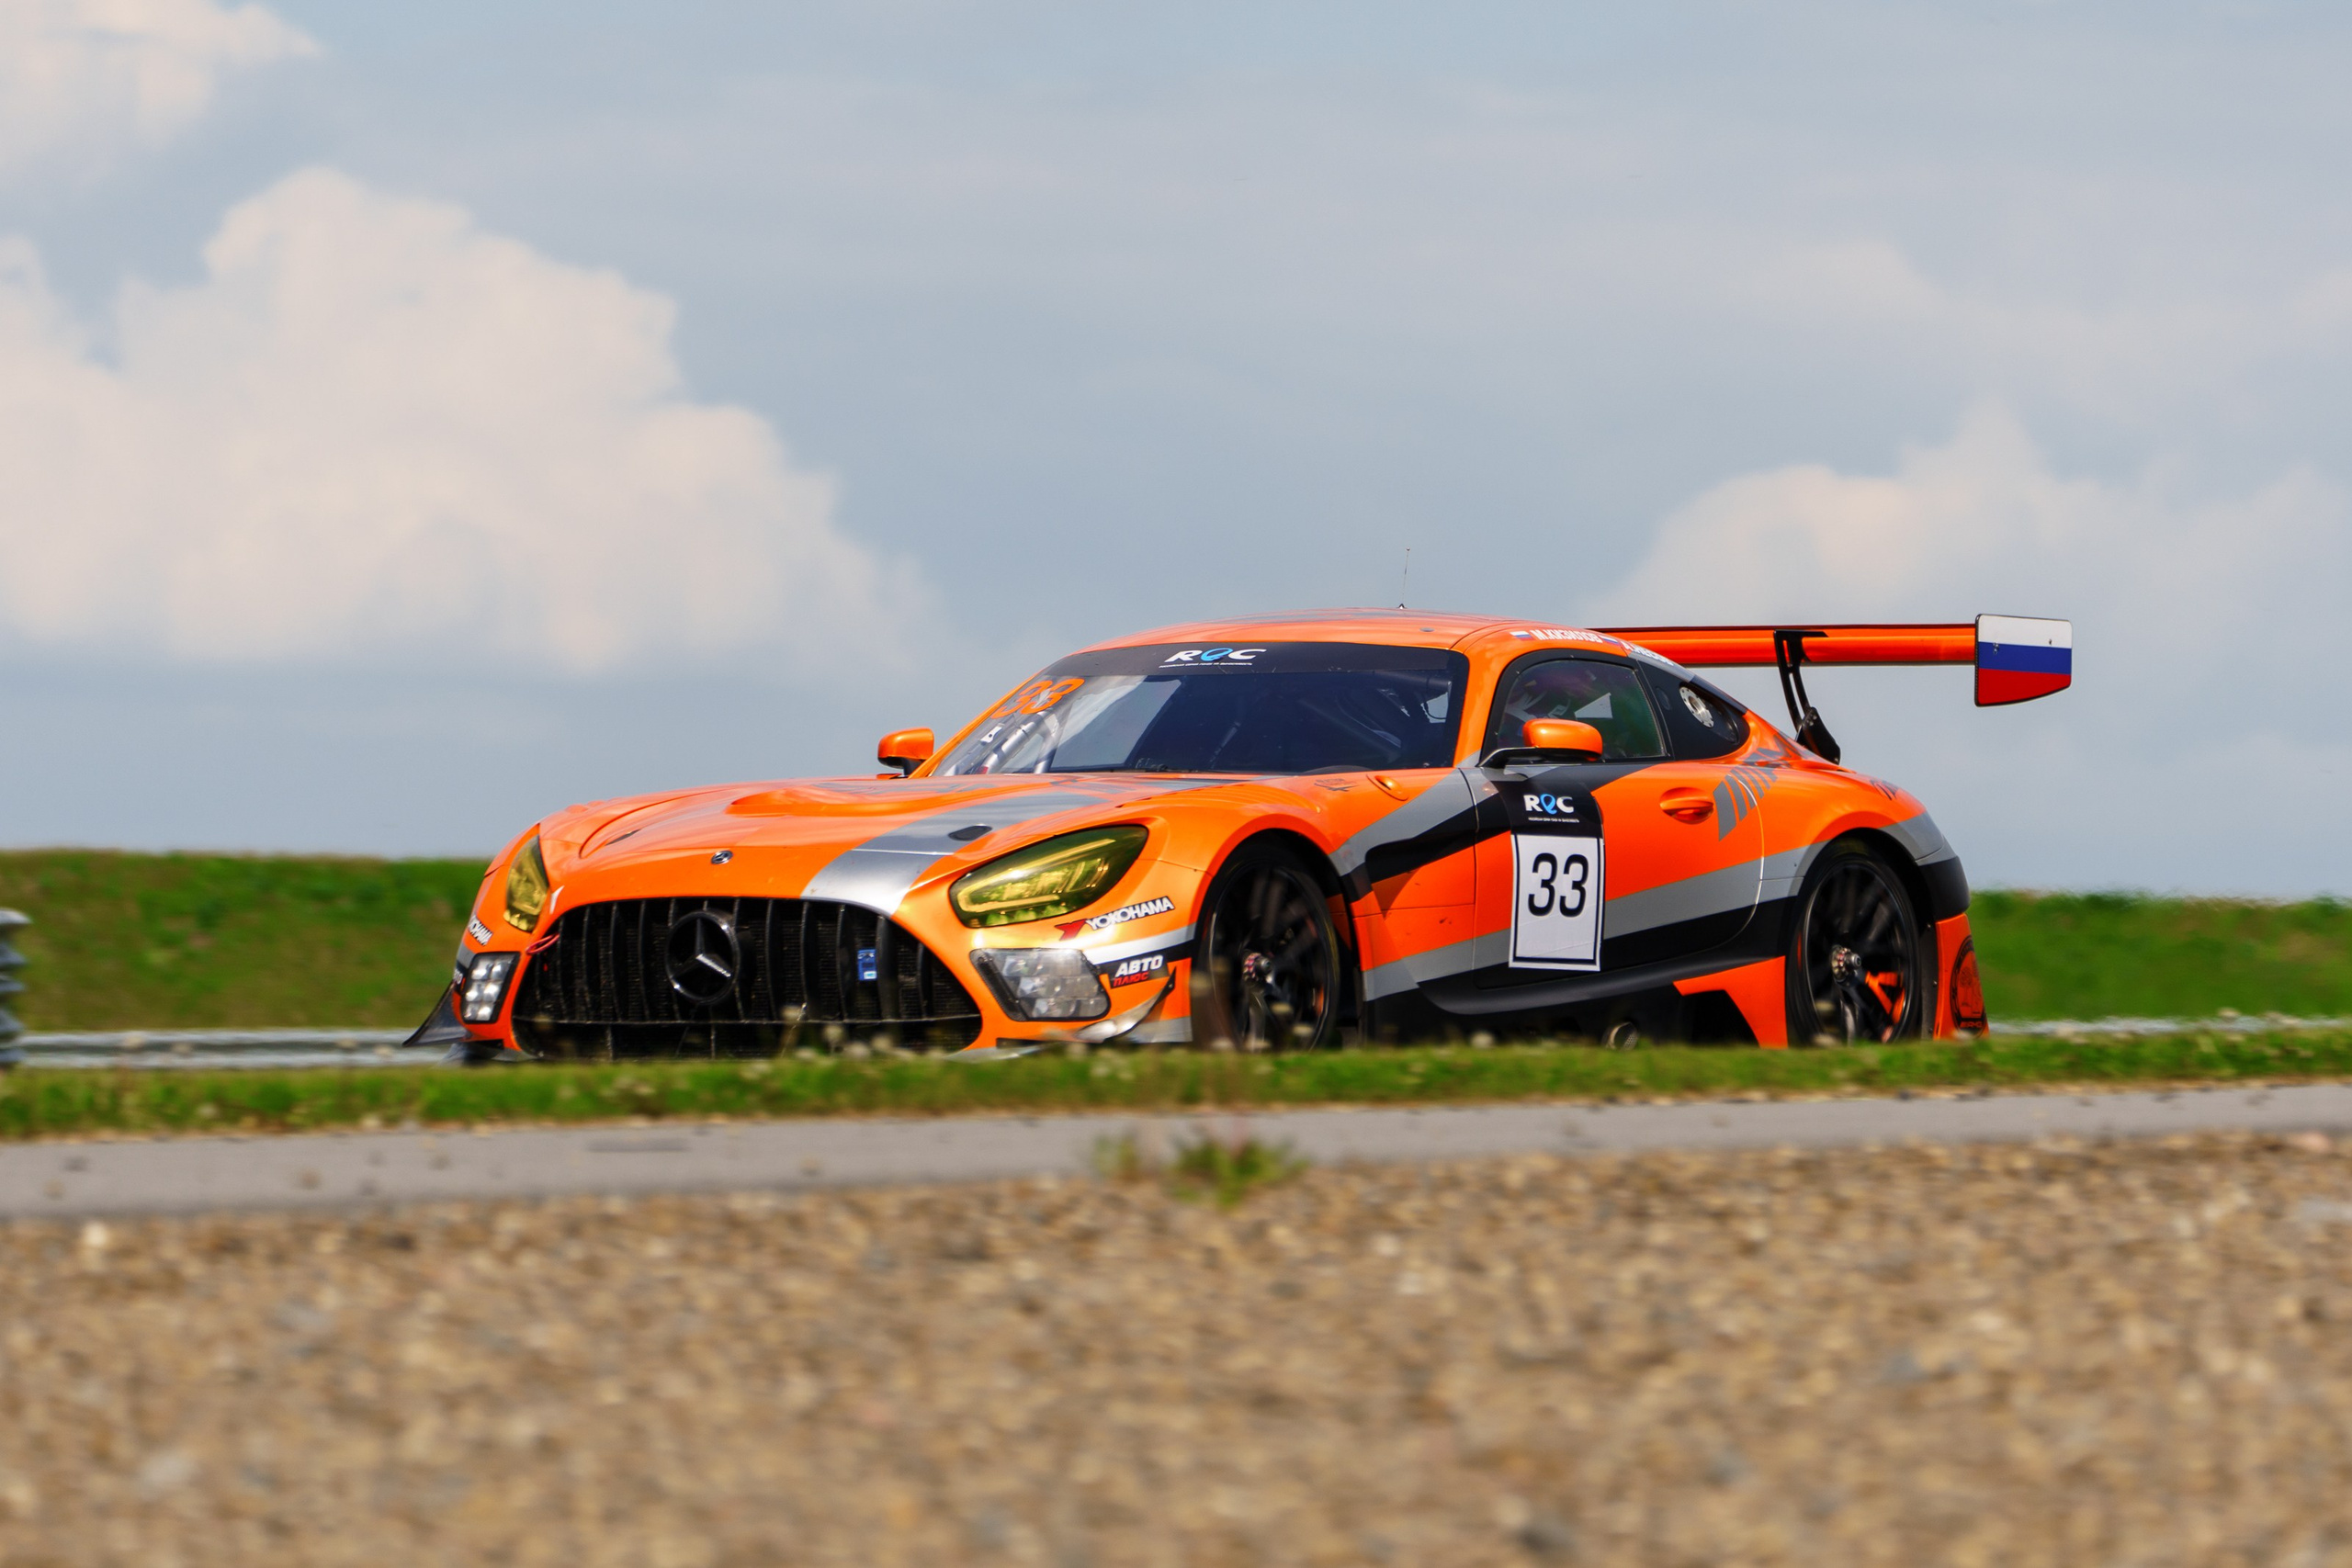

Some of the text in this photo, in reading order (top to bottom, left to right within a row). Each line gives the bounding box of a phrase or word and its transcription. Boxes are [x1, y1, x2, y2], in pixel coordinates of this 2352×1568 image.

[991, 678, 1085, 719] 33
[1528, 852, 1589, 918] 33
[1085, 896, 1175, 931] YOKOHAMA
[1113, 971, 1149, 987] ПЛЮС
[1115, 955, 1163, 977] АВТО
